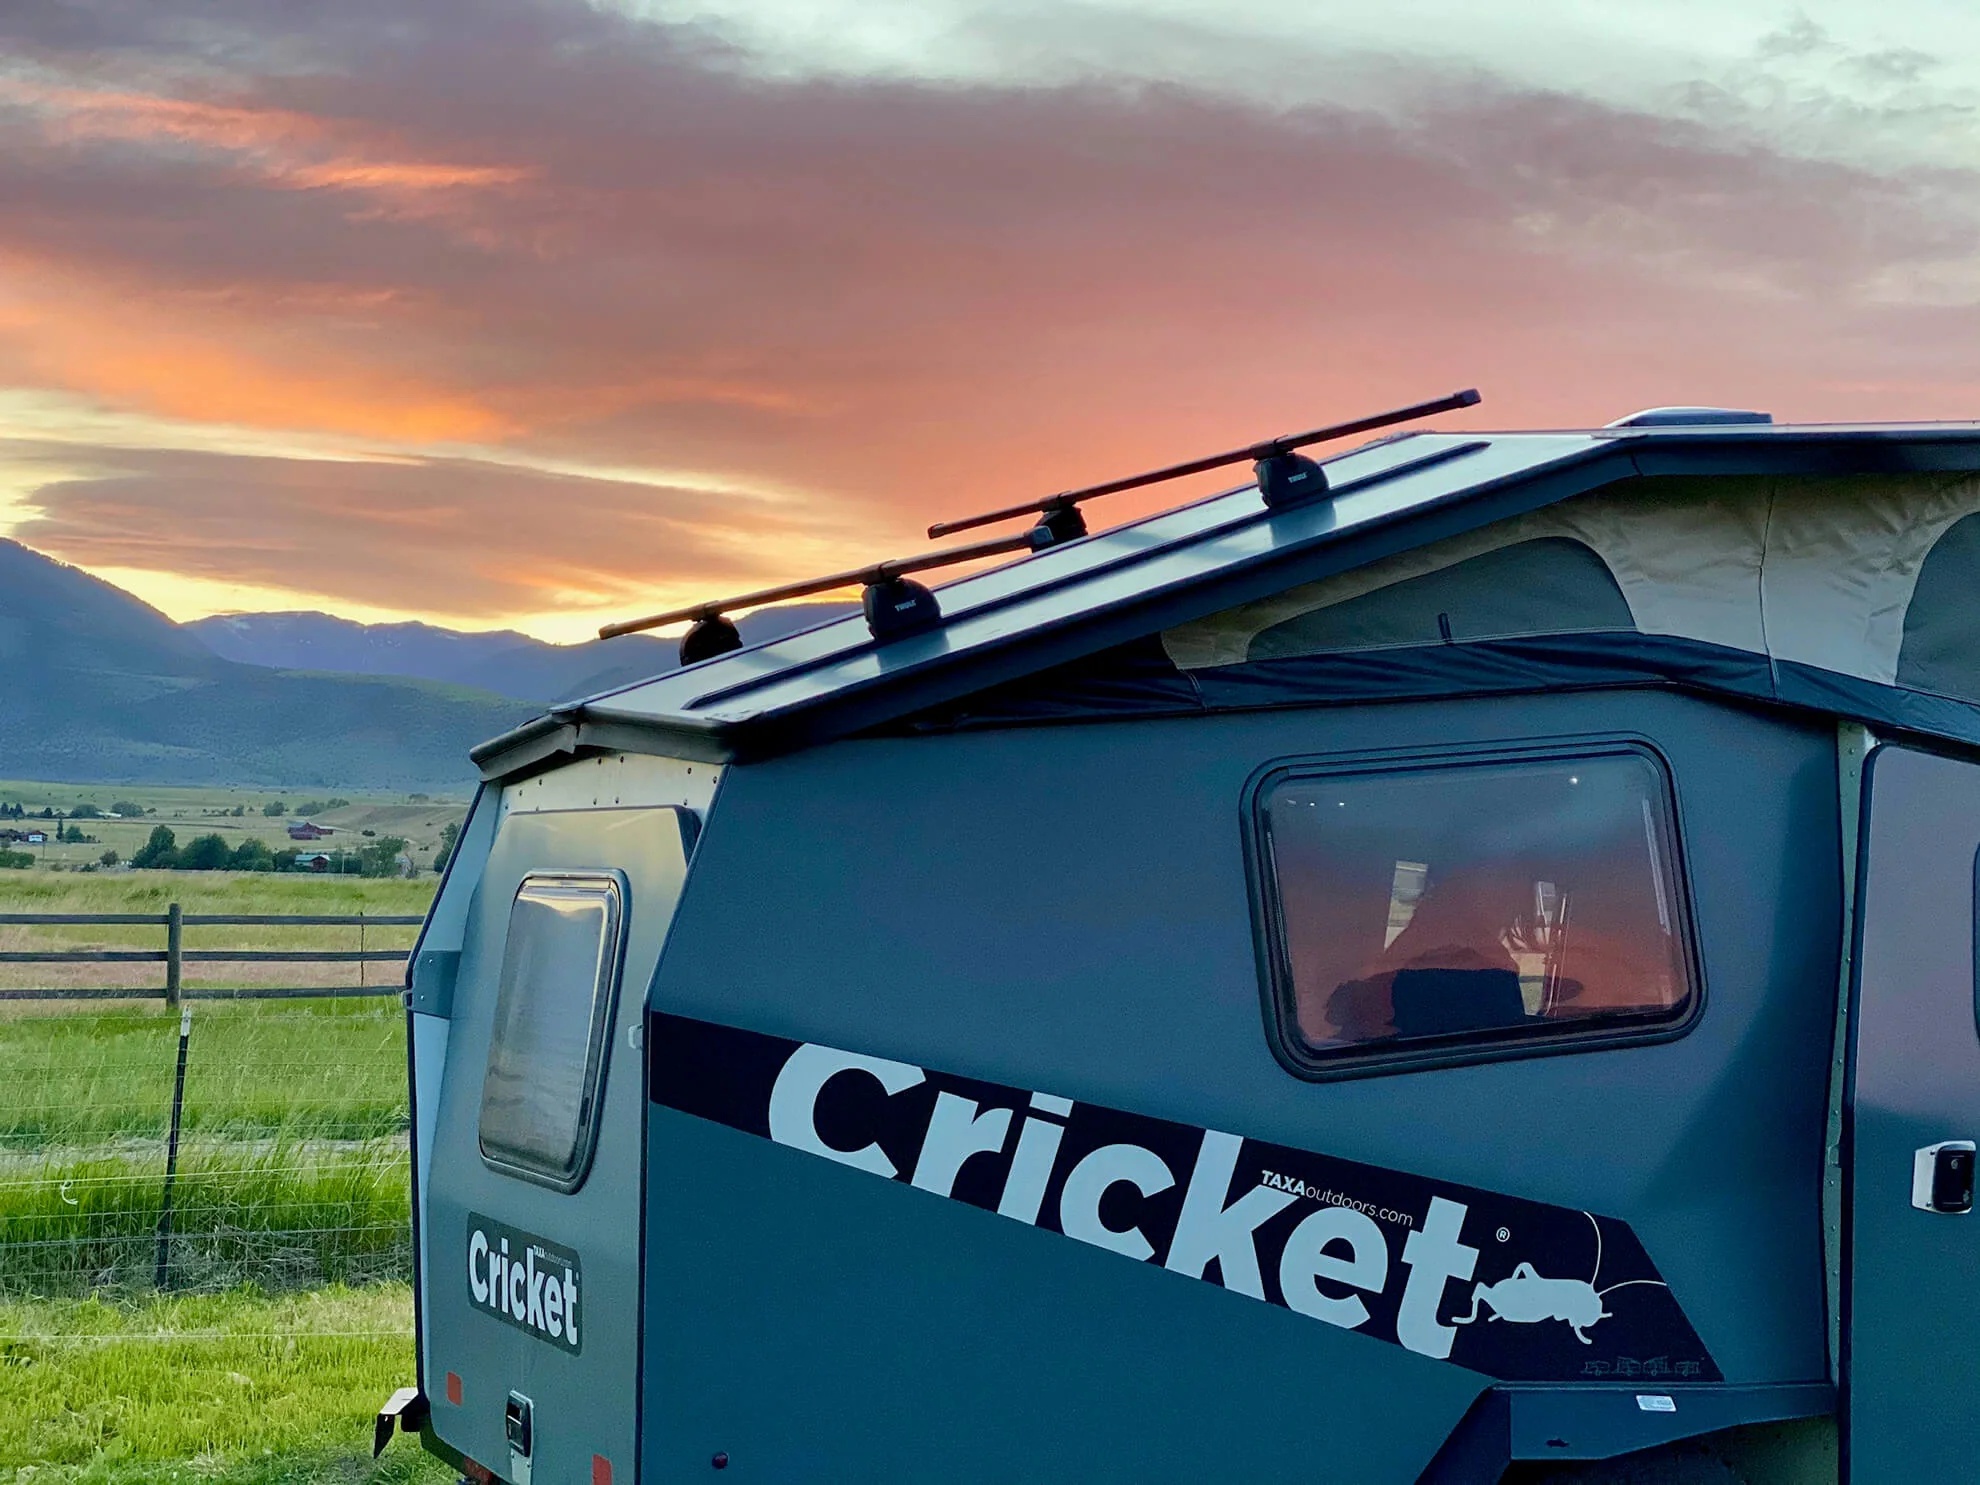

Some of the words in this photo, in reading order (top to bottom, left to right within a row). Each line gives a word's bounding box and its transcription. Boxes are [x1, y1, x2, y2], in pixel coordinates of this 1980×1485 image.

[769, 1043, 1480, 1359] Cricket
[1261, 1169, 1413, 1227] TAXAoutdoors.com
[469, 1230, 578, 1346] Cricket
